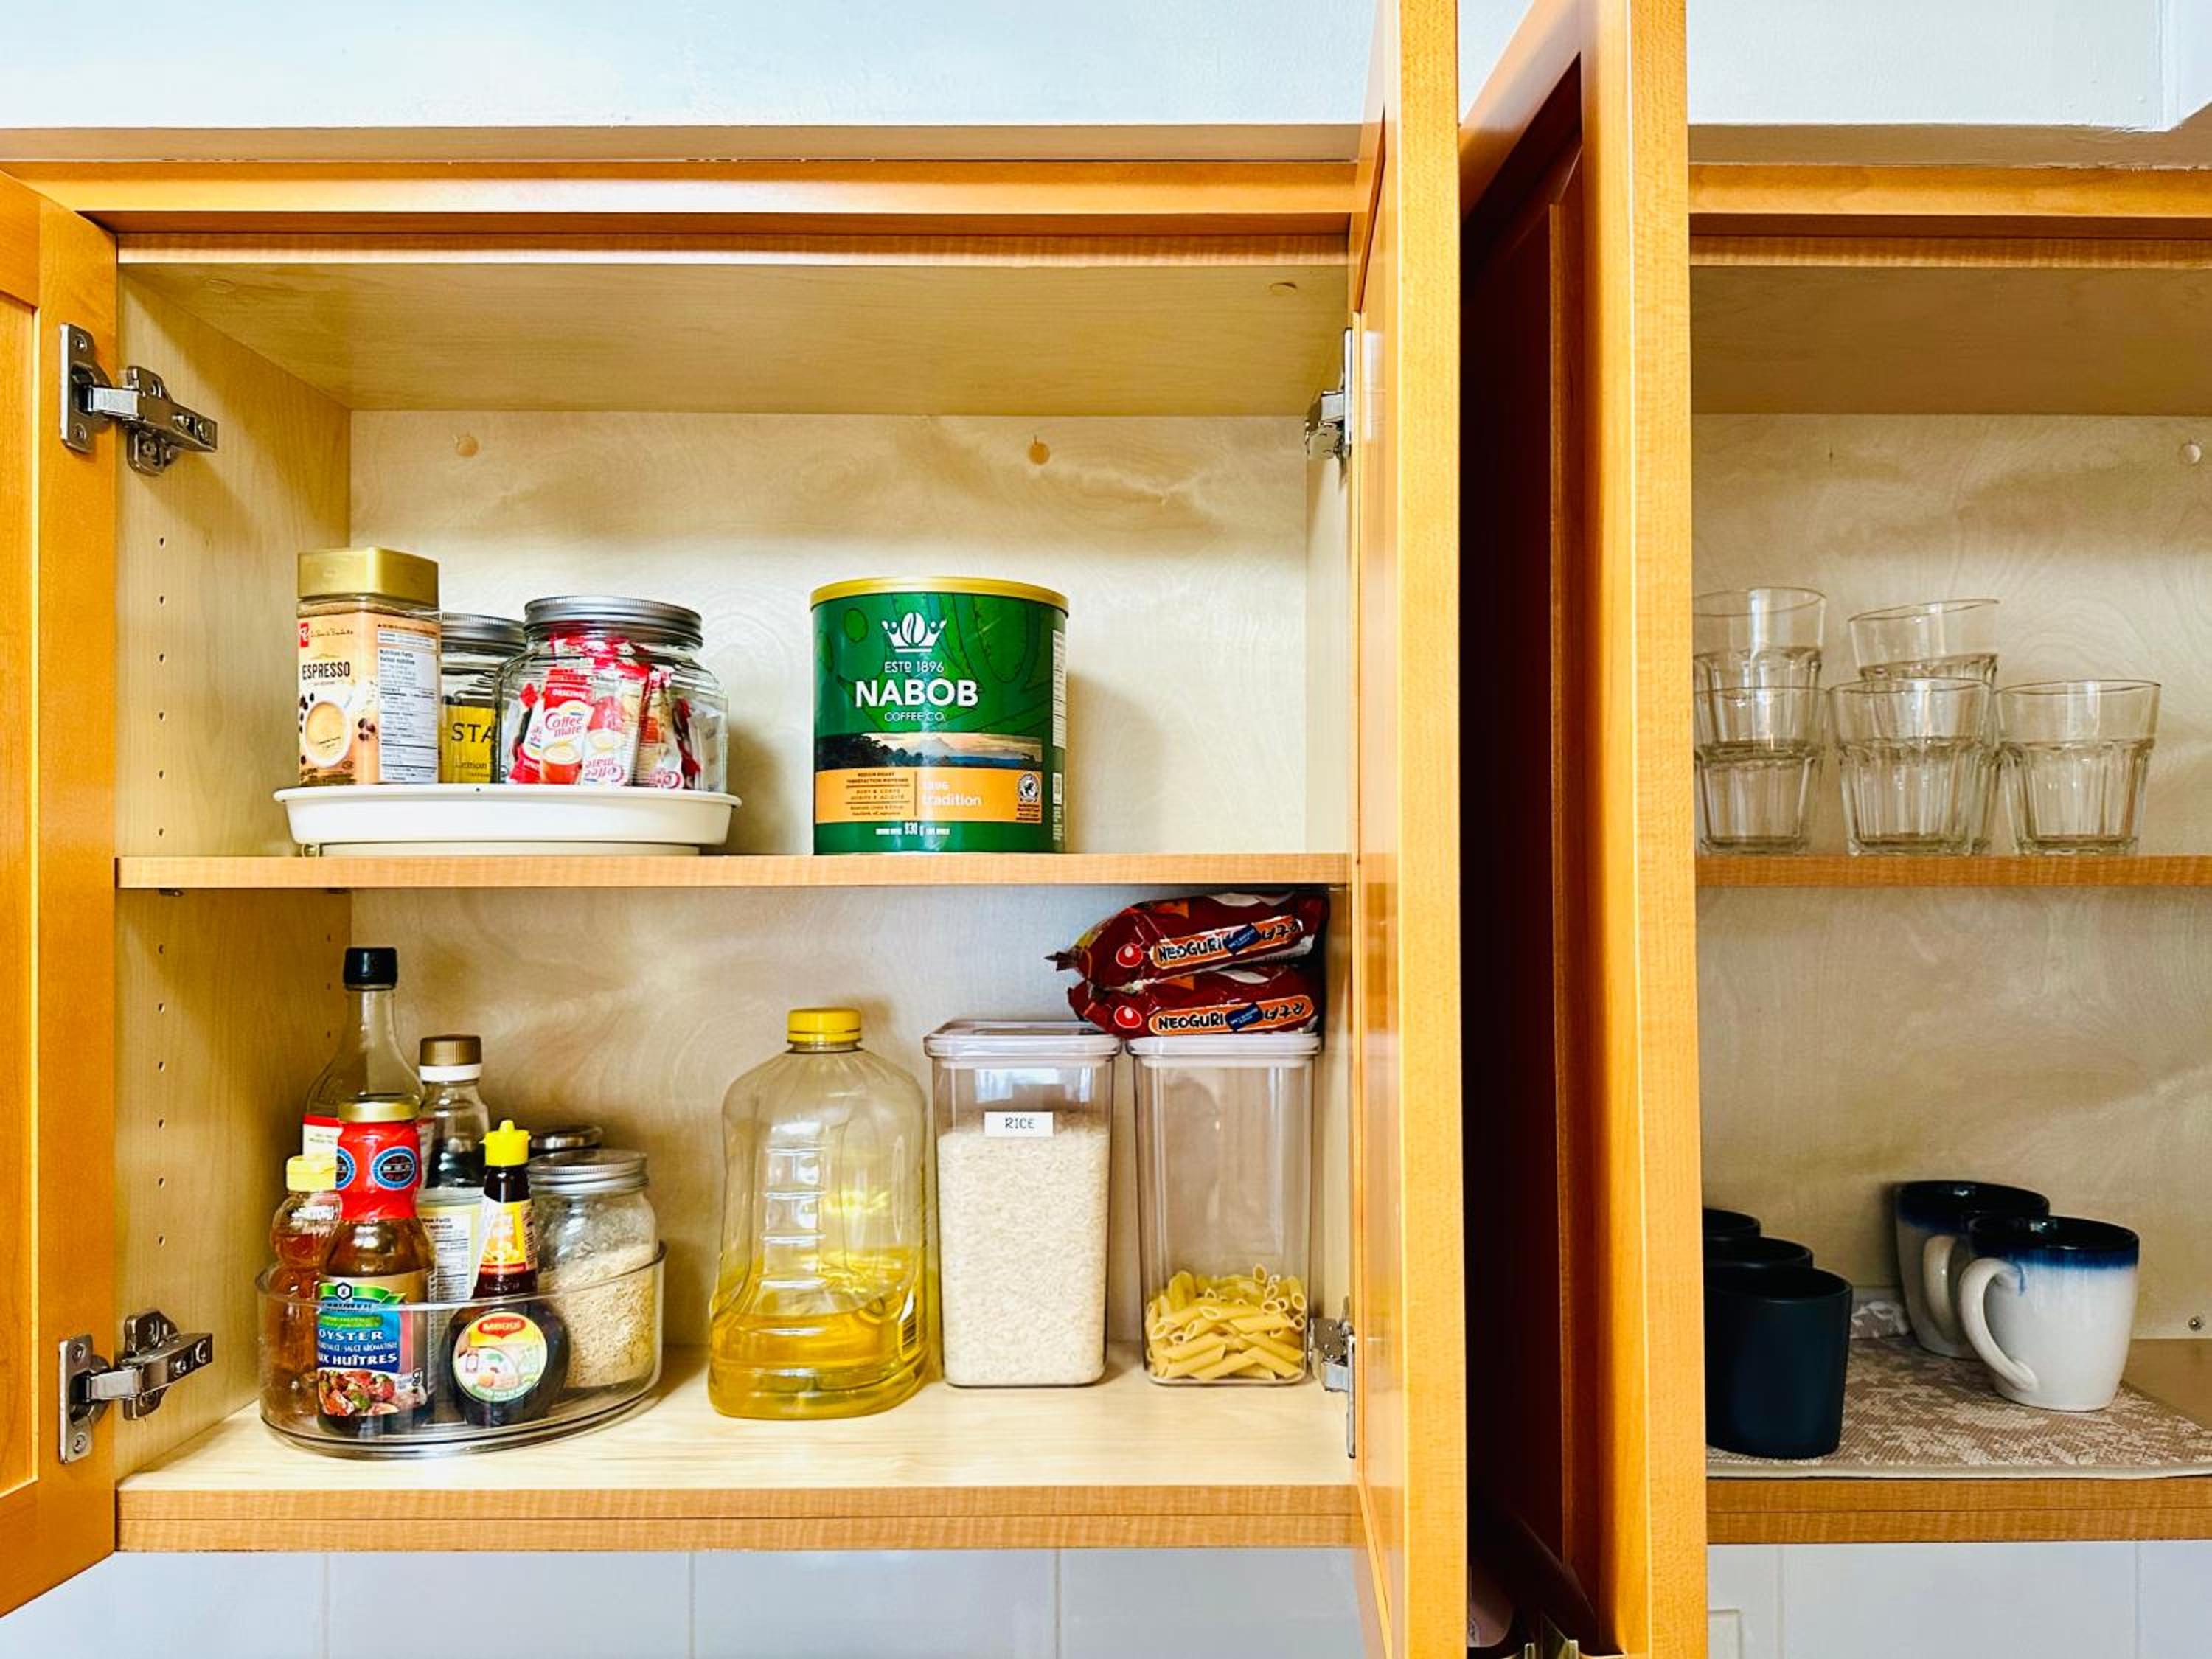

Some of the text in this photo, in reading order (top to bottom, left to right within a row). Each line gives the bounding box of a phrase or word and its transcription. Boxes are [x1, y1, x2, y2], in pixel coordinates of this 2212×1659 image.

[302, 661, 351, 681] ESPRESSO
[917, 661, 945, 673] 1896
[855, 678, 978, 709] NABOB
[545, 712, 583, 730] Coffee
[884, 712, 922, 722] COFFEE
[554, 726, 582, 737] mate
[1158, 938, 1223, 962] NEOGURI
[1158, 1013, 1224, 1030] NEOGURI
[1005, 1117, 1035, 1129] RICE
[319, 1329, 383, 1341] OYSTER
[333, 1353, 397, 1366] HUÎTRES
